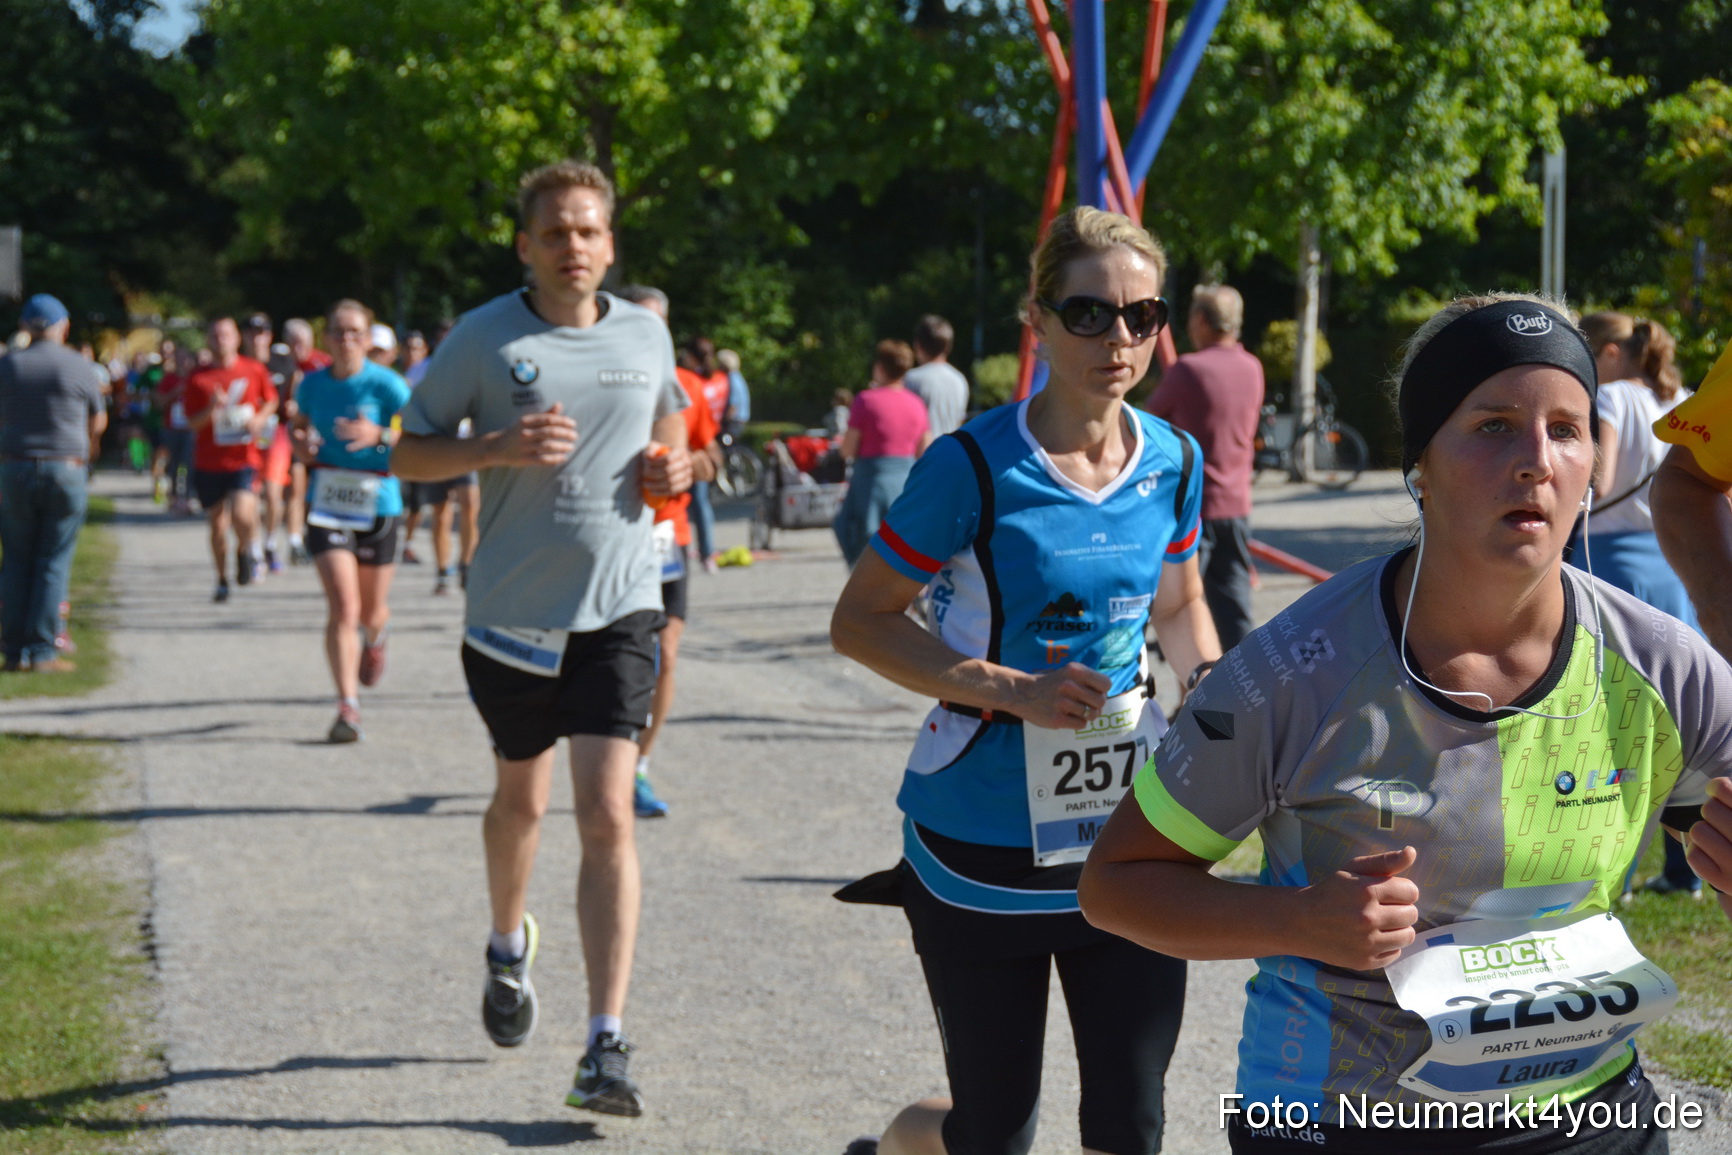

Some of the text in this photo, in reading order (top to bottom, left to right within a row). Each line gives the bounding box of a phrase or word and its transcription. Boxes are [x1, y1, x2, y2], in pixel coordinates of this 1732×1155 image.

[1065, 800, 1100, 812] PARTL
[1555, 793, 1621, 809] PARTL NEUMARKT
[1459, 936, 1565, 974] BOCK
[1464, 972, 1498, 984] inspired
[1498, 970, 1508, 980] by
[1509, 967, 1533, 977] smart
[1444, 970, 1640, 1036] 2235
[1482, 1029, 1602, 1056] PARTL Neumarkt
[1497, 1056, 1579, 1085] Laura
